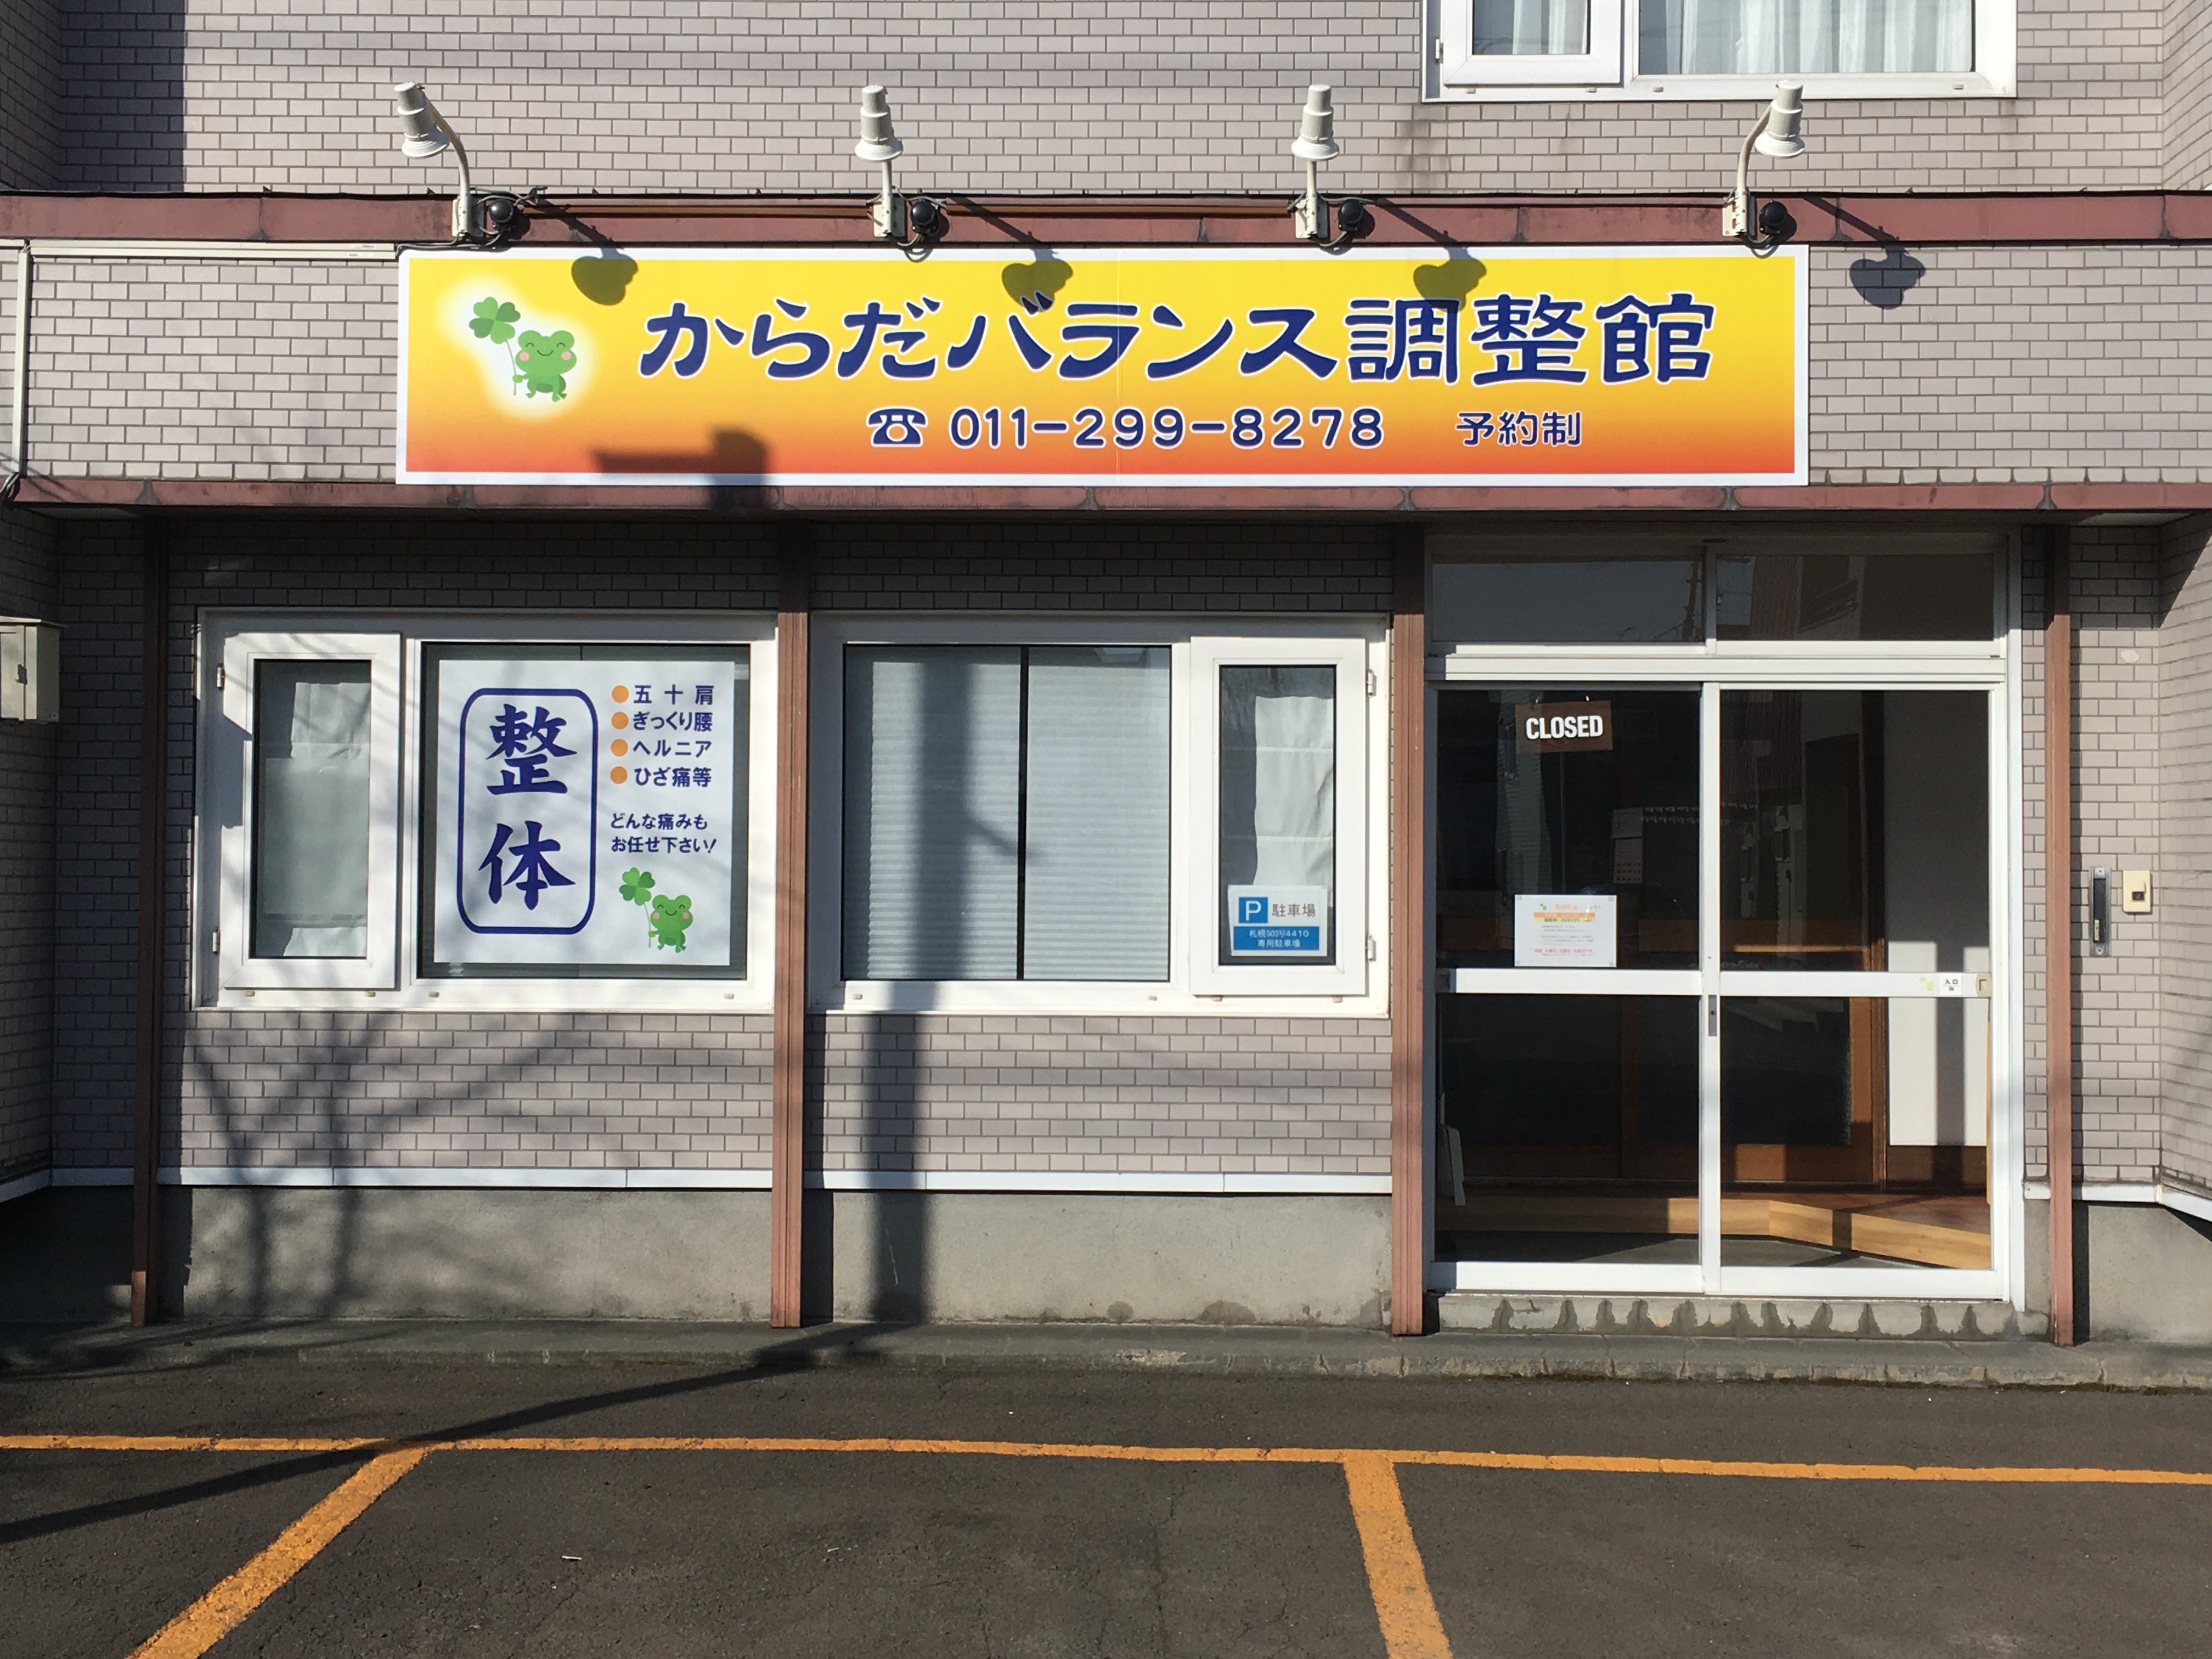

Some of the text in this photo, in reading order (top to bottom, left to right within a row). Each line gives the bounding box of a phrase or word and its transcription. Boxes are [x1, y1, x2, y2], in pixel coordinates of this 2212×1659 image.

[639, 293, 1715, 386] からだバランス調整館
[950, 407, 1582, 449] 011-299-8278 予約制
[633, 712, 713, 732] ぎっくり腰
[1526, 715, 1604, 740] CLOSED
[633, 740, 712, 757] ヘルニア
[634, 767, 712, 788] ひざ痛等
[478, 703, 577, 910] 整体
[610, 813, 708, 831] どんな痛みも
[1245, 900, 1316, 921] P 駐車場
